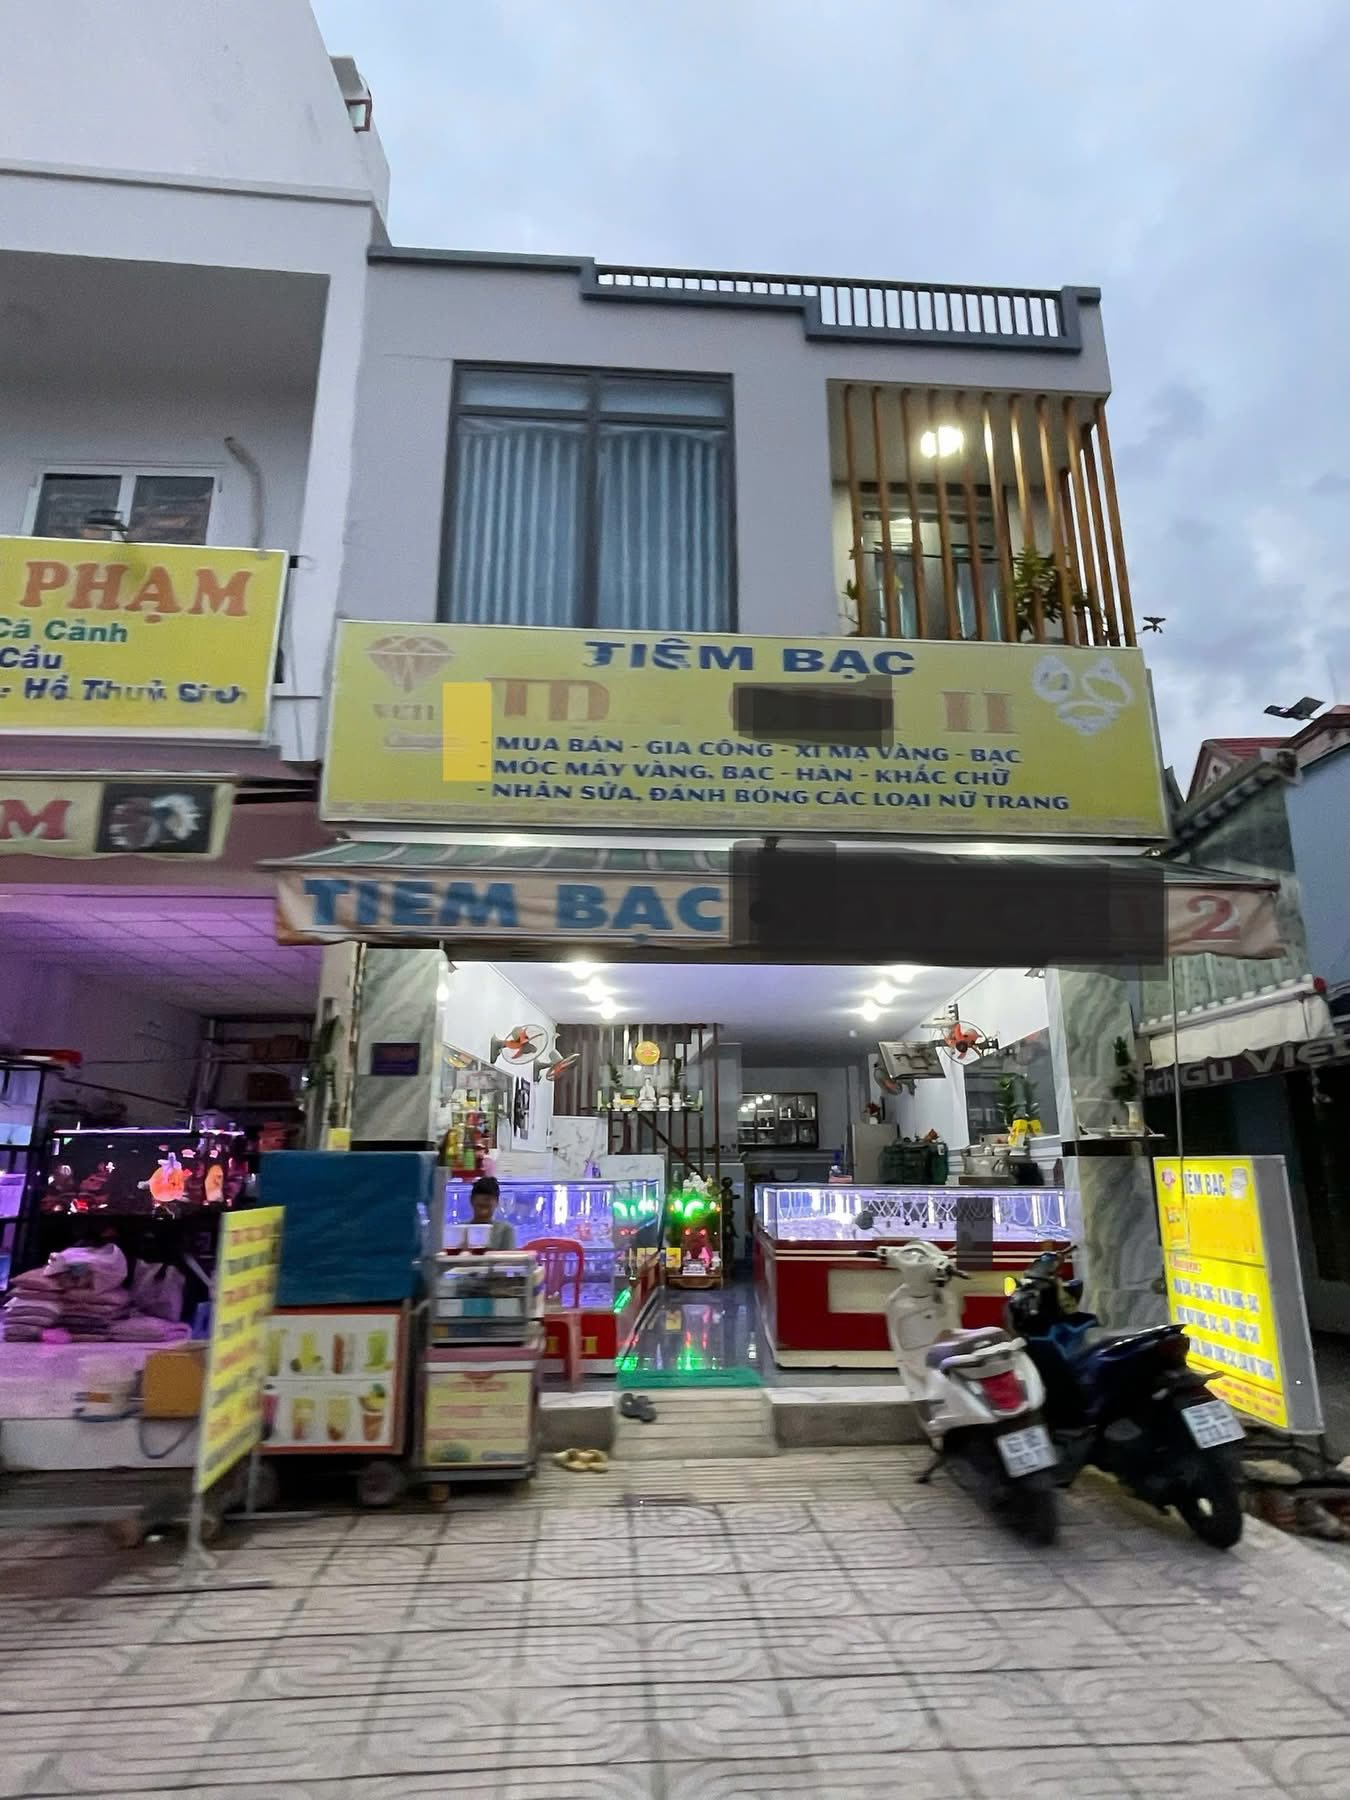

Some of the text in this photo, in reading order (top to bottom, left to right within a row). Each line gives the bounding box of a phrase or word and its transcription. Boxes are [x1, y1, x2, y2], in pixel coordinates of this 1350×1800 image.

[19, 560, 253, 624] PHẠM
[782, 647, 915, 680] BẠC
[496, 736, 560, 751] MUA
[568, 735, 624, 753] BÁN
[646, 740, 692, 755] GIA
[700, 738, 774, 758] CÔNG
[795, 744, 821, 758] XI
[876, 743, 949, 762] VÀNG
[970, 748, 1022, 766] BẠC
[493, 756, 558, 775] MÓC
[565, 758, 627, 777] MÁY
[722, 765, 775, 784] BẠC
[796, 763, 853, 782] HÀN
[954, 768, 1010, 786] CHỮ
[648, 783, 726, 803] ĐÁNH
[735, 786, 809, 805] BÓNG
[815, 787, 868, 806] CÁC
[873, 791, 931, 811] LOẠI
[939, 790, 977, 809] NỮ
[983, 794, 1070, 810] TRANG
[556, 882, 724, 943] BẠC
[1186, 894, 1241, 940] 2
